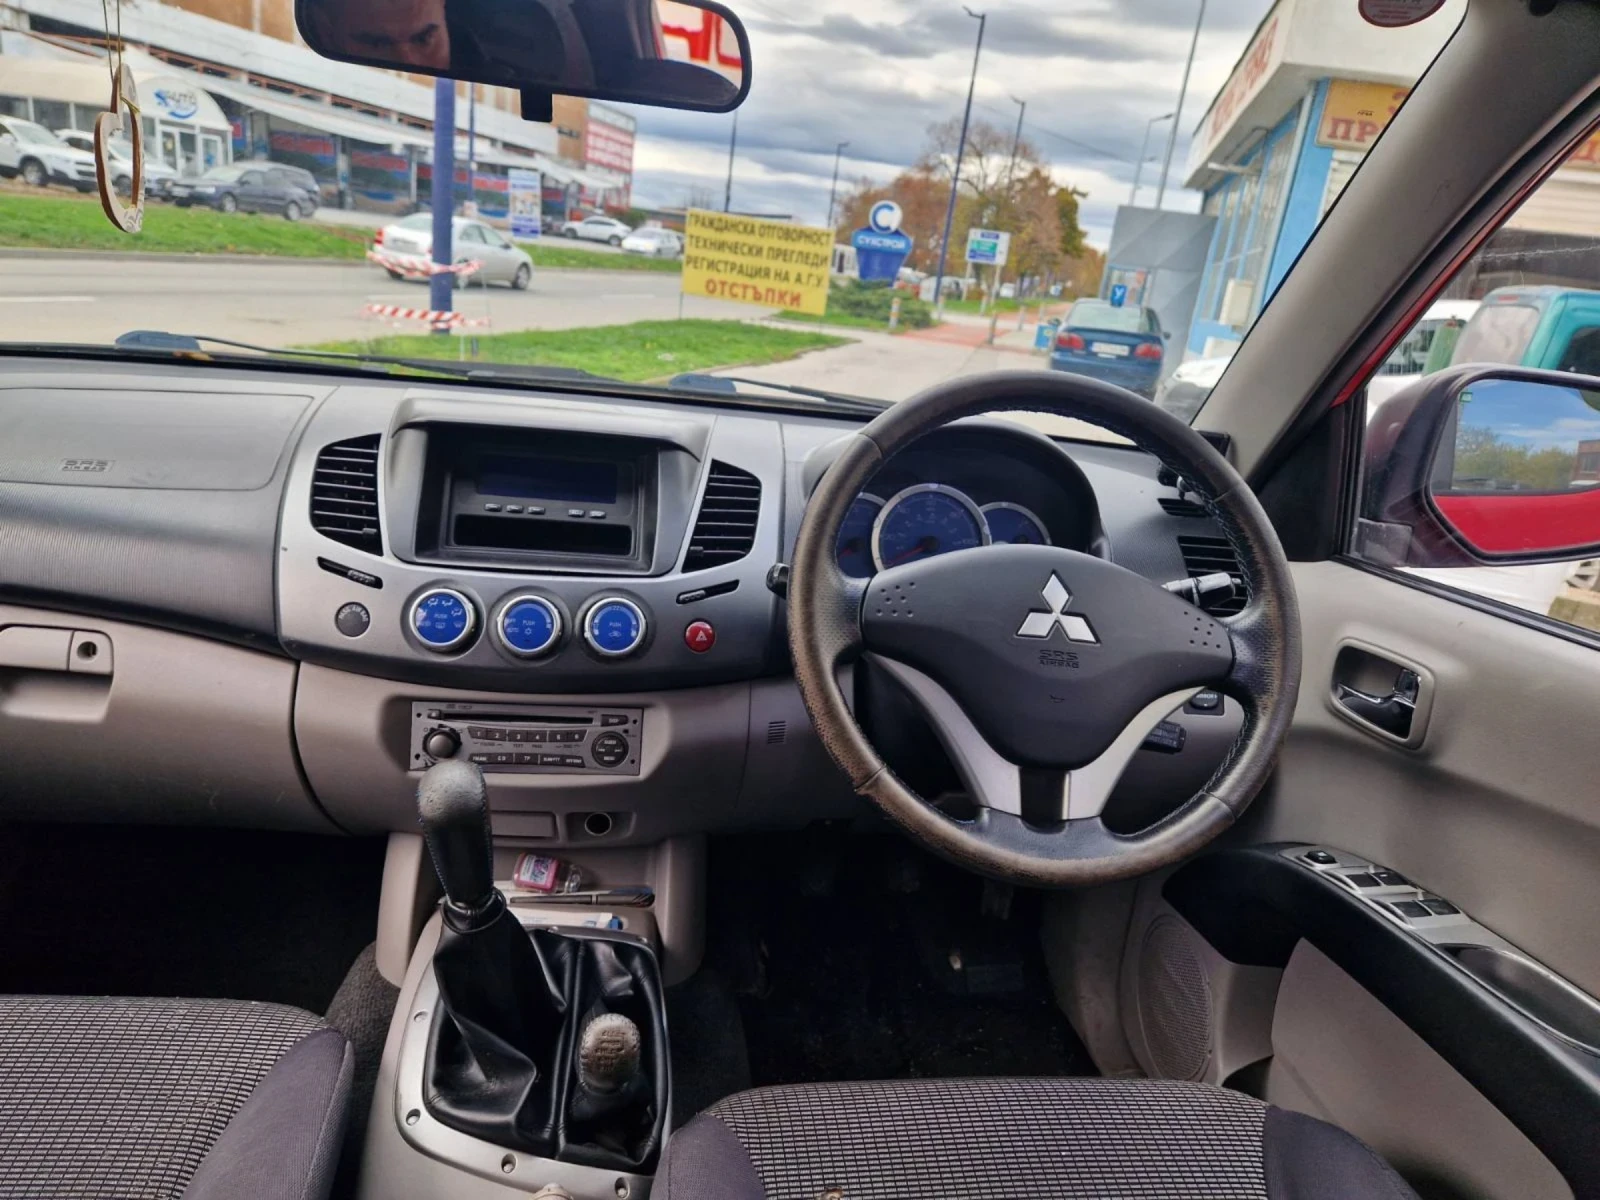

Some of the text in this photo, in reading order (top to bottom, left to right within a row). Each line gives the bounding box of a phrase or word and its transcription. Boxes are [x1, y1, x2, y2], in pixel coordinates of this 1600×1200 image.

[689, 213, 831, 247] ГРАЖДАНСКА ОТГОВОРНОСТ
[689, 235, 829, 269] ТЕХНИЧЕСКИ ПРЕГЛЕДИ
[686, 255, 771, 280] РЕГИСТРАЦИЯ
[774, 269, 790, 283] НА
[705, 279, 802, 307] ОТСТЪПКИ
[1039, 649, 1078, 661] SRS
[1039, 660, 1079, 669] AIRBAG
